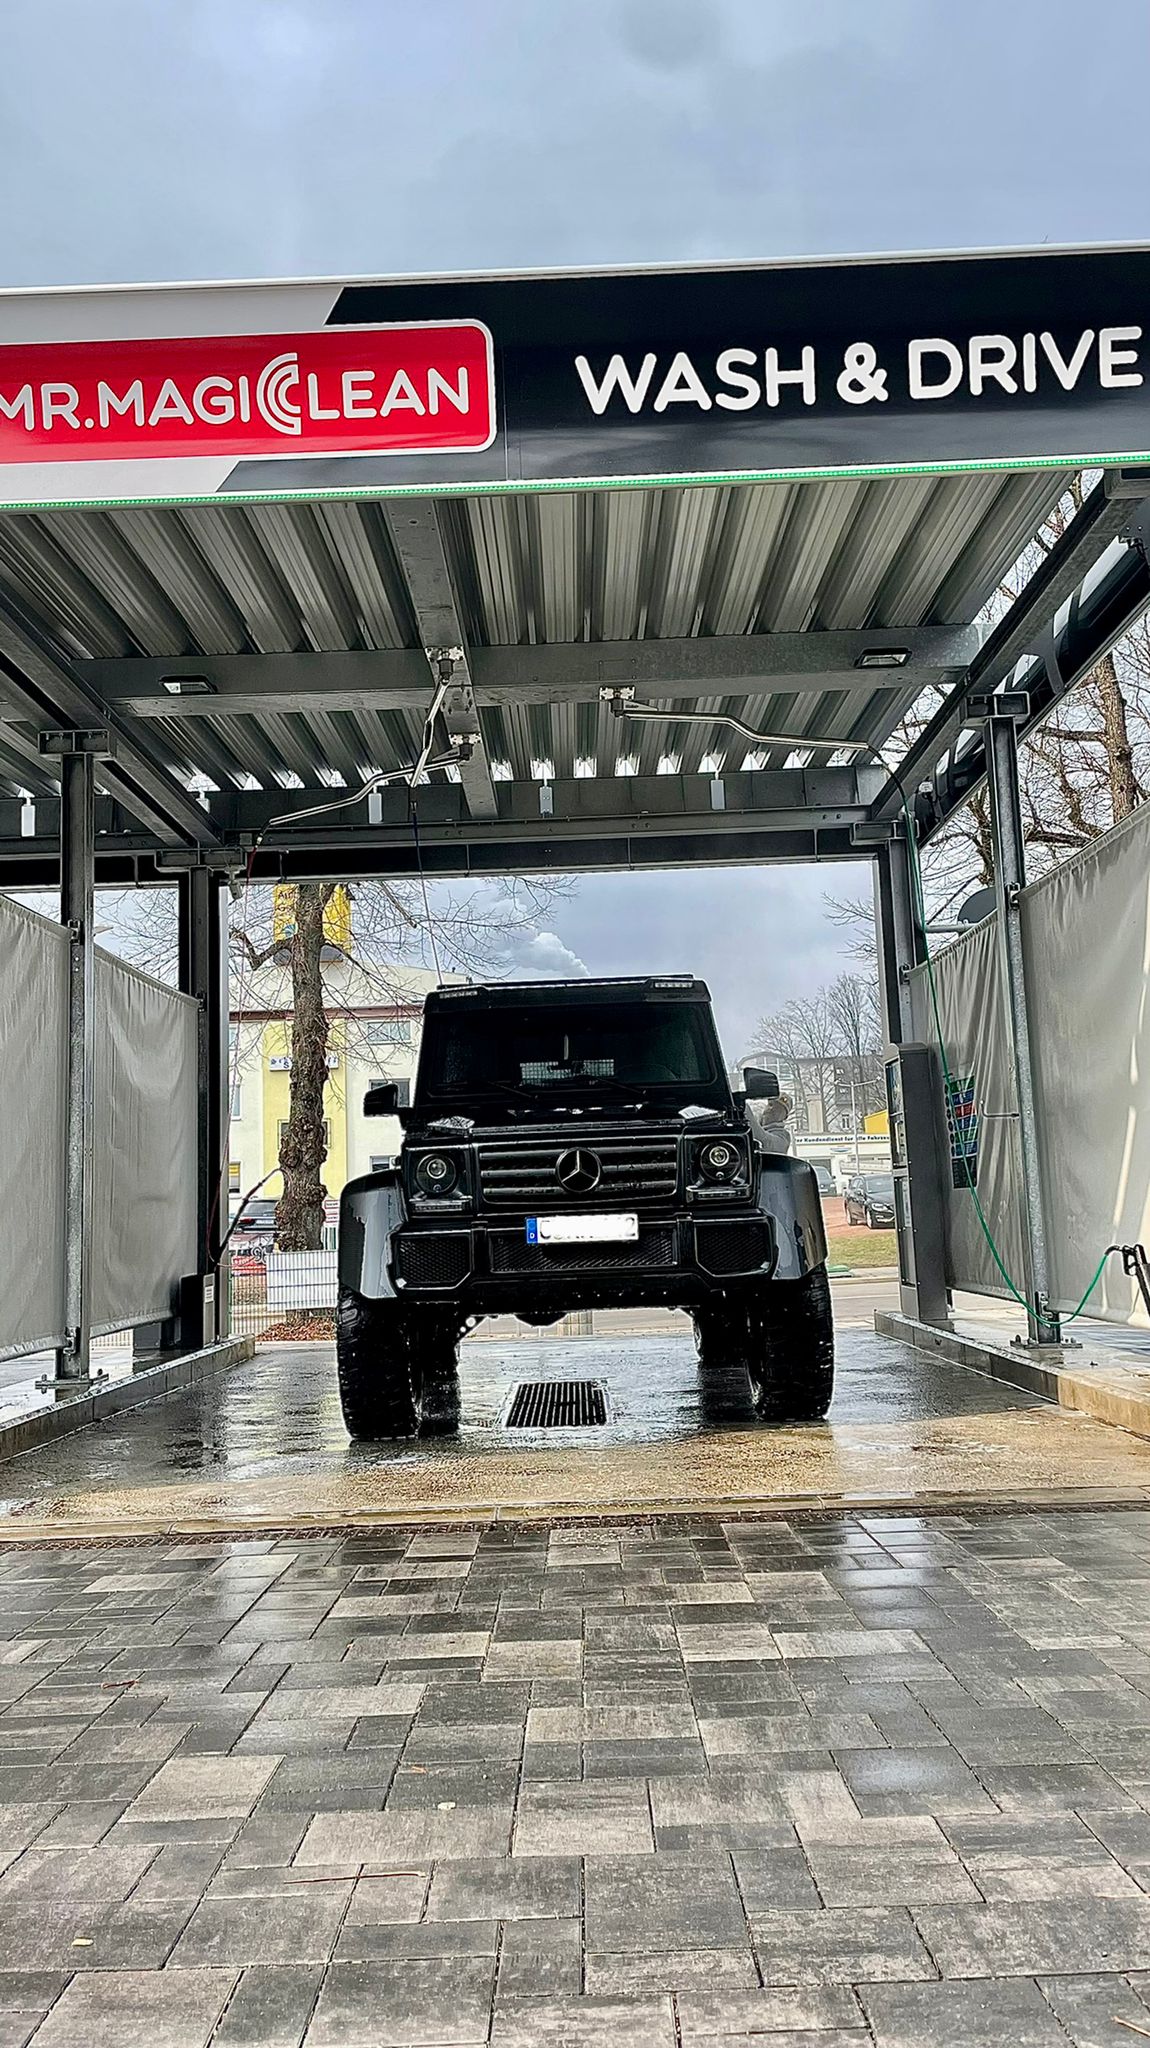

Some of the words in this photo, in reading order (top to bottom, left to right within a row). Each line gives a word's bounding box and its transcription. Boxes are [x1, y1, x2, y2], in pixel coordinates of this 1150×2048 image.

[575, 346, 816, 415] WASH
[836, 342, 889, 404] &
[909, 326, 1144, 399] DRIVE
